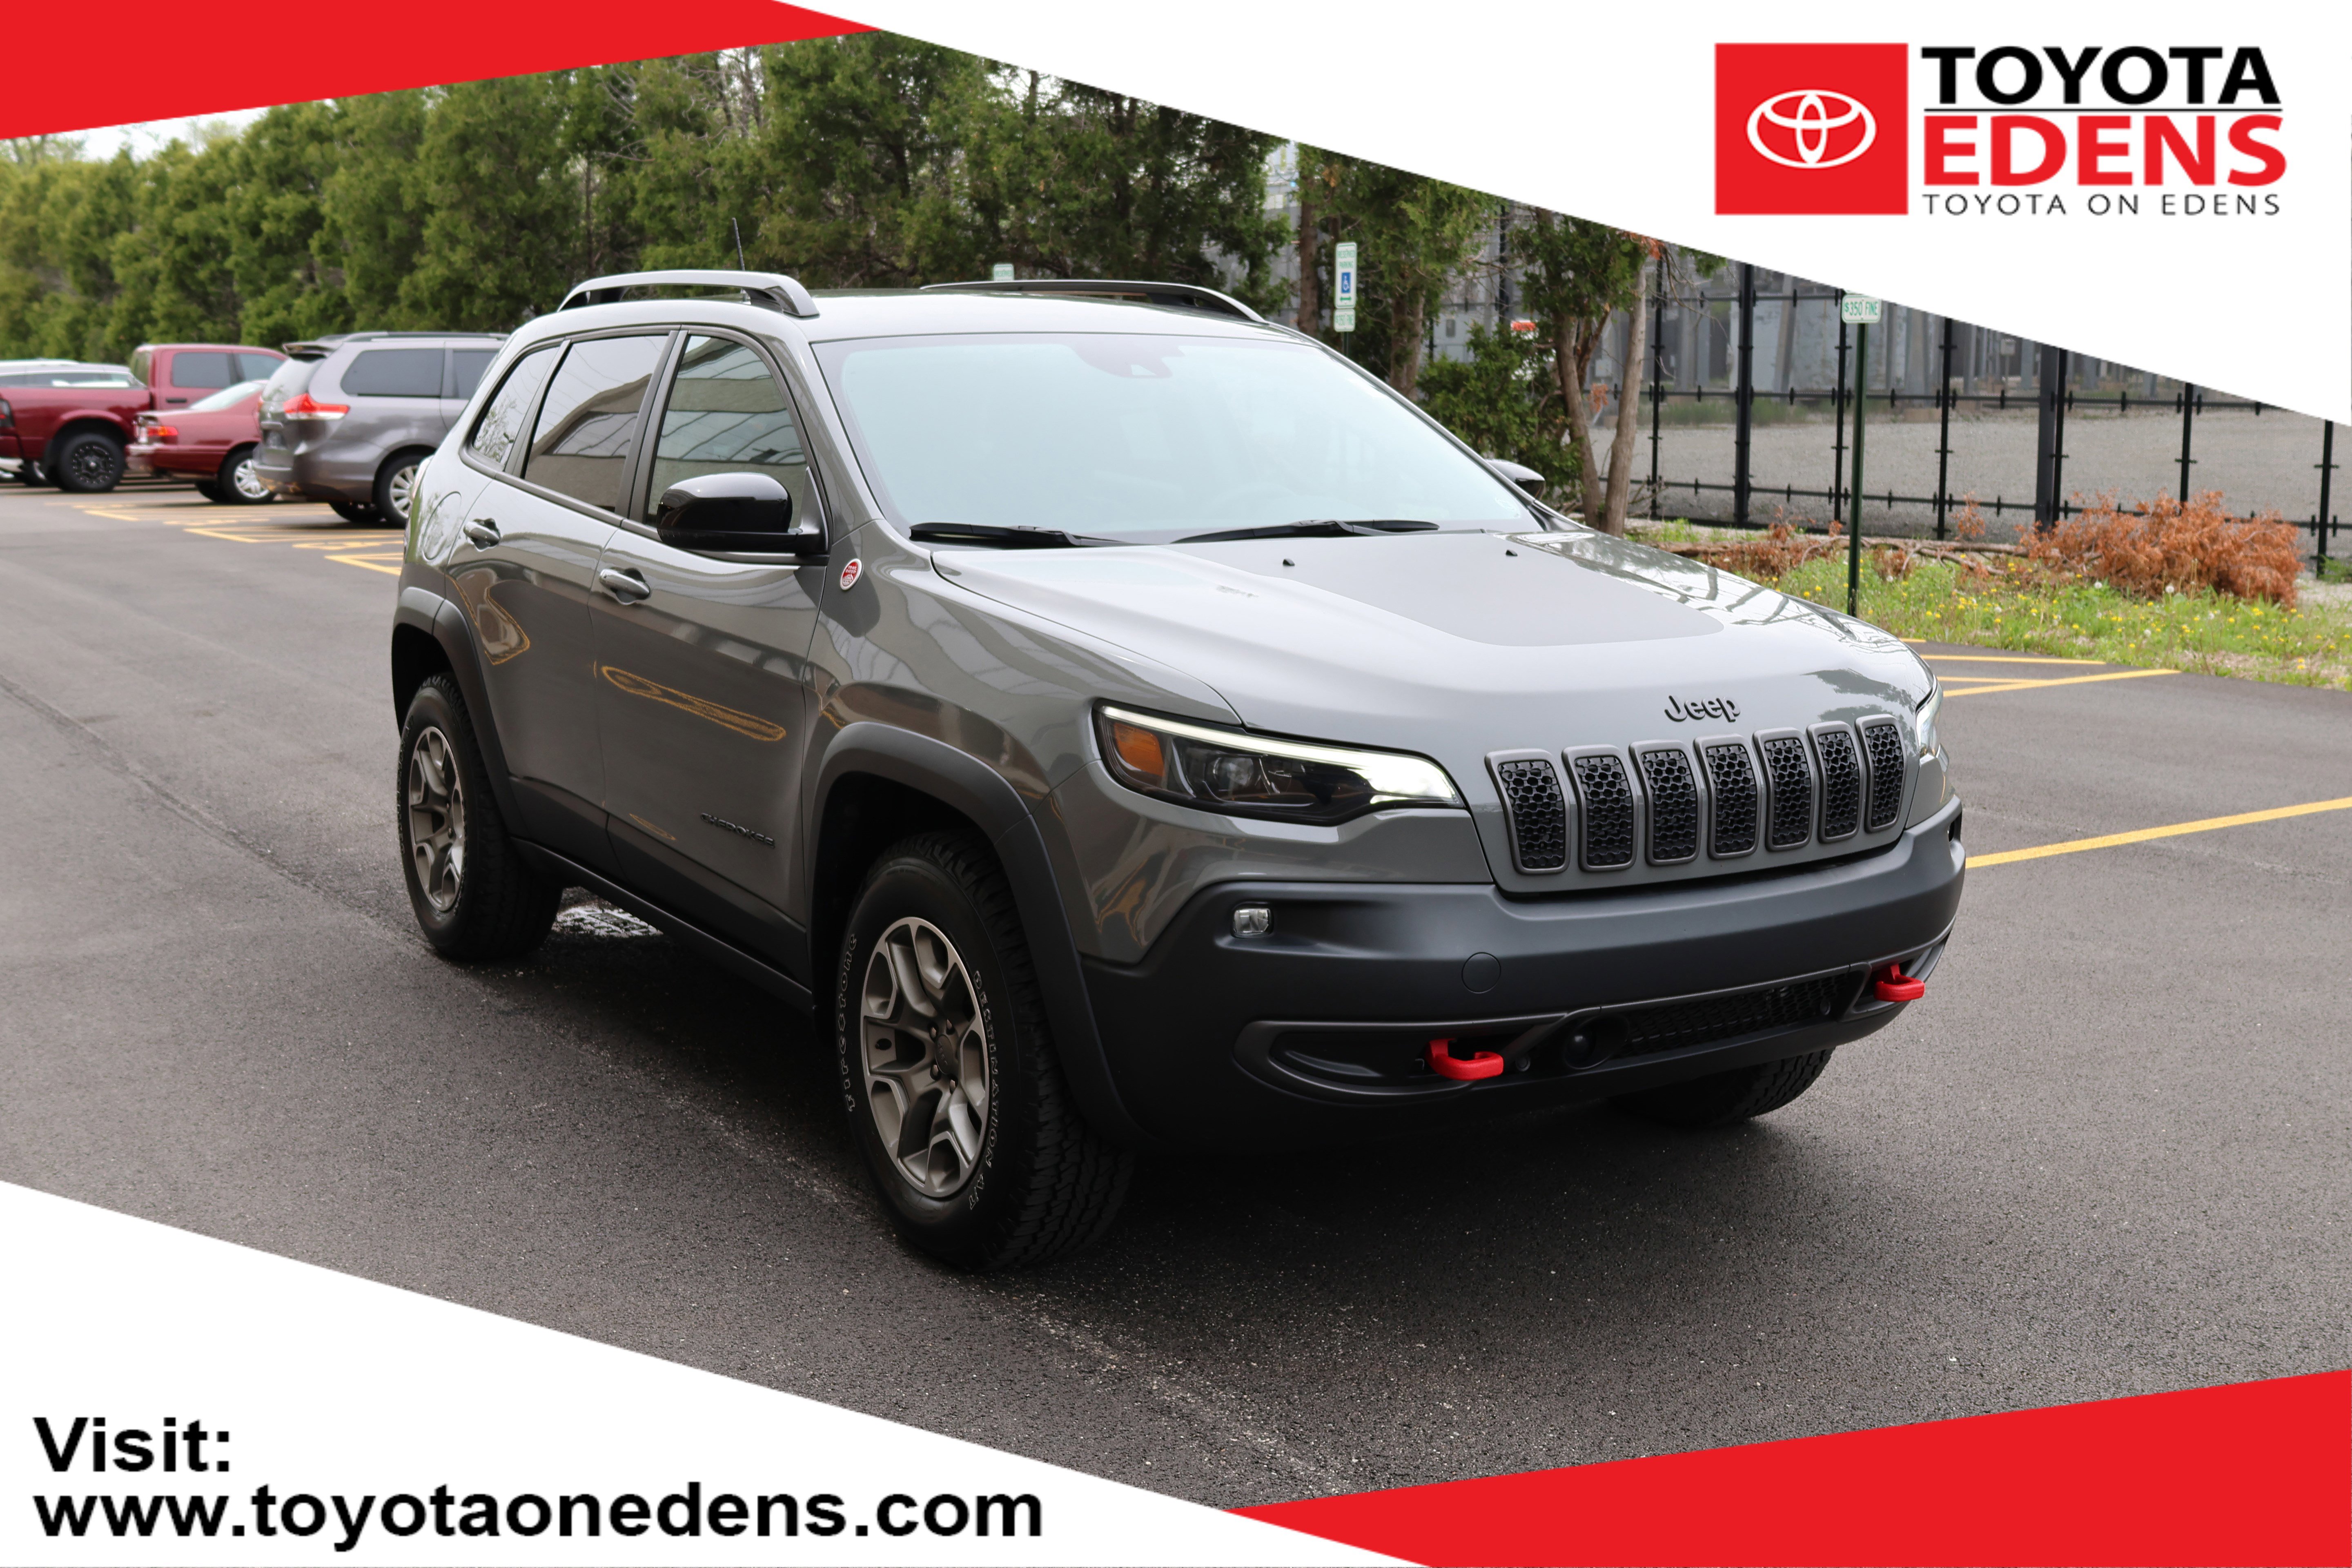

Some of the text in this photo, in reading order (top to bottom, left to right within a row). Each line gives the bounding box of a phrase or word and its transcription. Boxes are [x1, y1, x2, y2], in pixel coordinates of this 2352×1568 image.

[1845, 301, 1878, 316] $350 FINE
[1664, 695, 1741, 722] Jeep
[969, 970, 999, 1210] DESTINATION A/T
